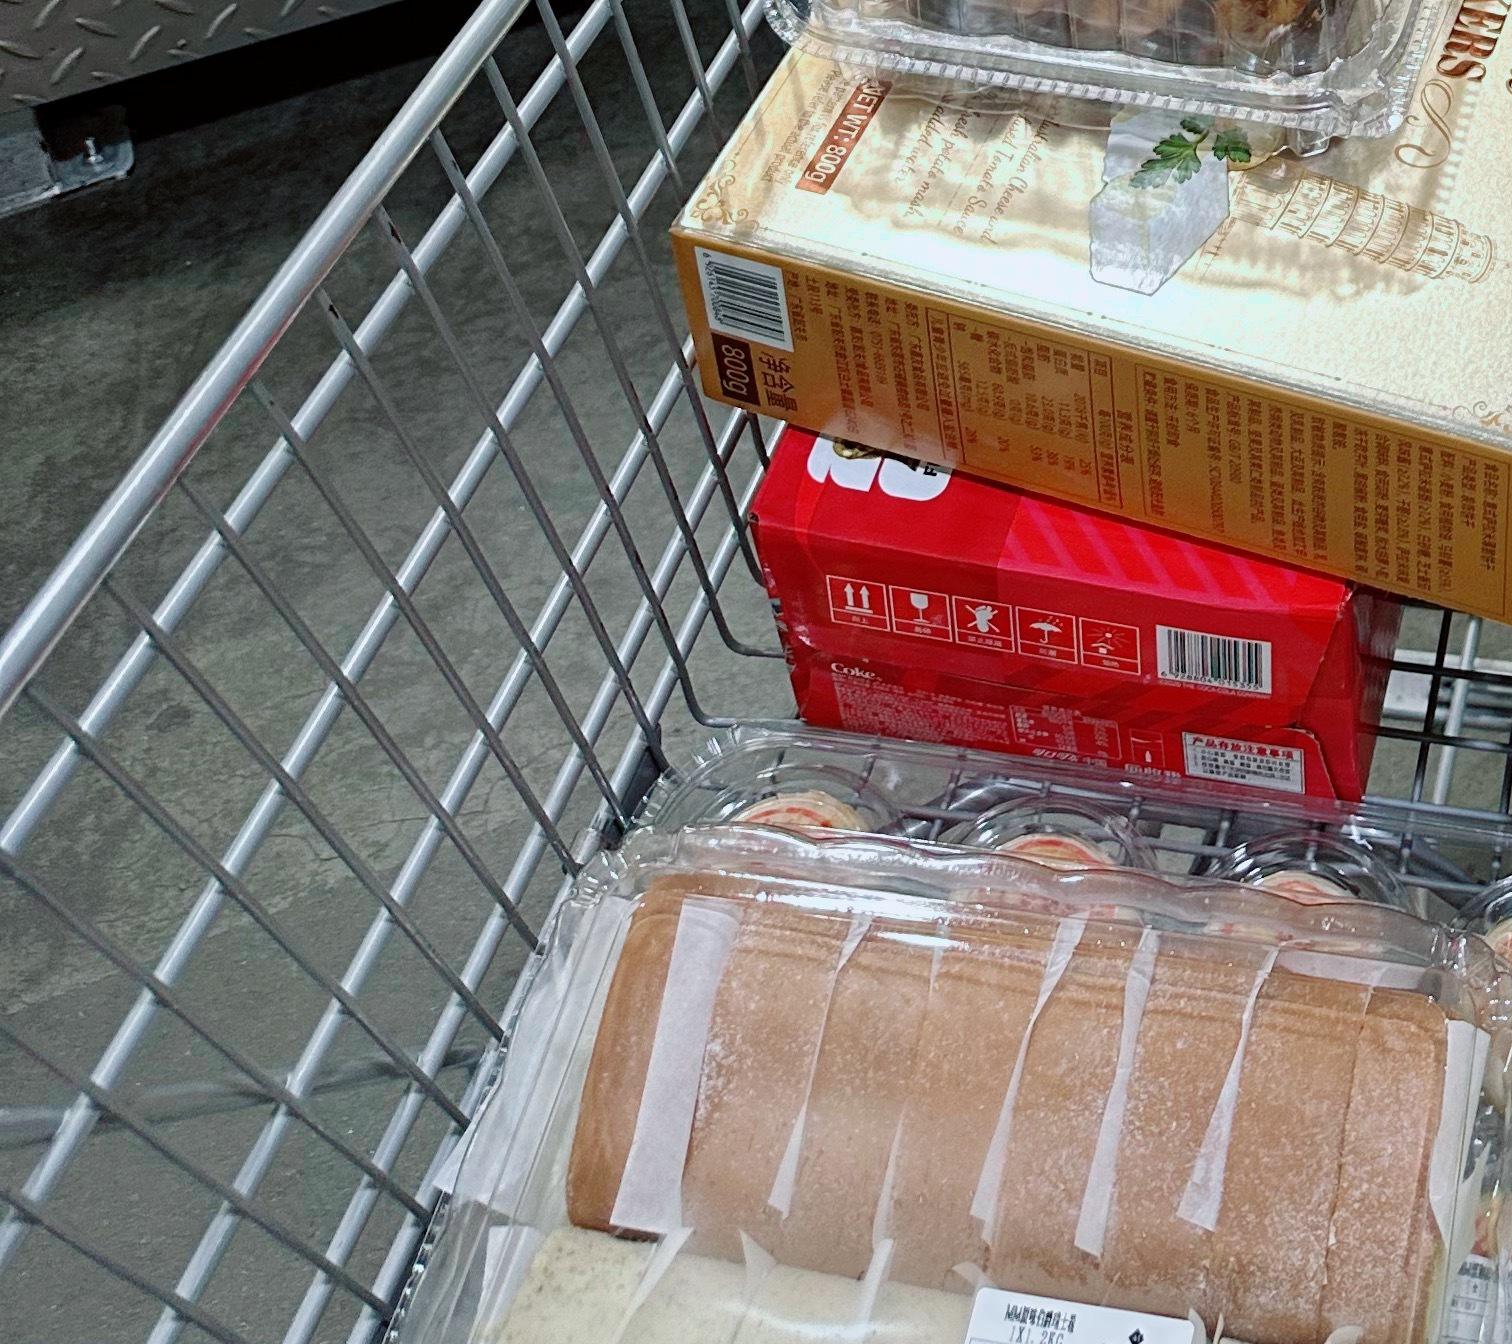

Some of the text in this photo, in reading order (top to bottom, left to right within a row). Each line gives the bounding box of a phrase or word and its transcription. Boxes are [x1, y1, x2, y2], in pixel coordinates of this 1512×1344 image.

[834, 109, 869, 143] WT:
[806, 143, 848, 185] 800g
[714, 340, 752, 397] 800g
[755, 349, 800, 416] 净含量
